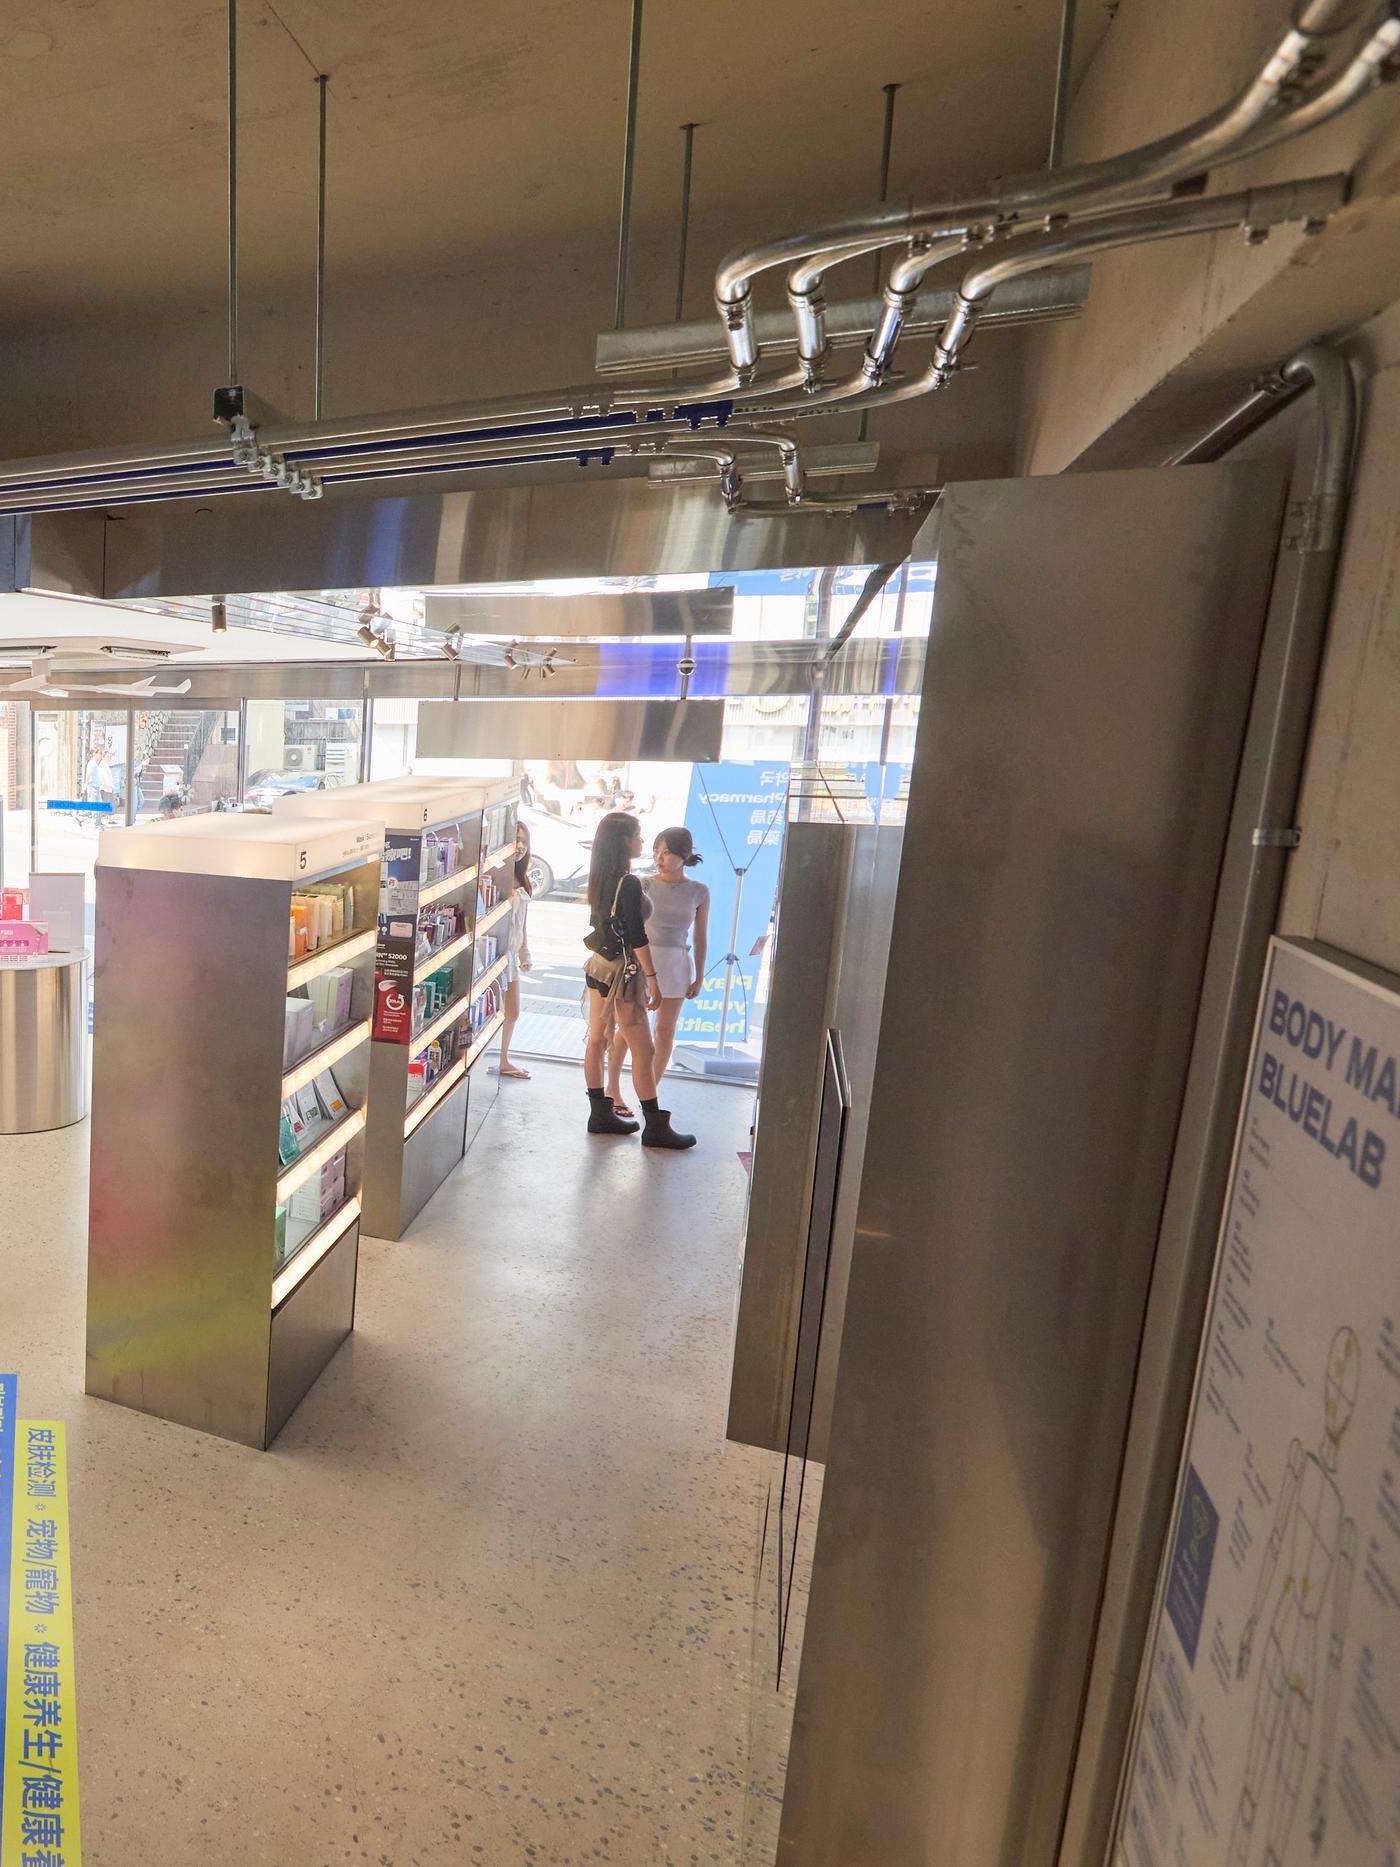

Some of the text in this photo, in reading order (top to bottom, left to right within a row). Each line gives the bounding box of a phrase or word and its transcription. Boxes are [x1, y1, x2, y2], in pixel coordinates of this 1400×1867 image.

[423, 808, 429, 822] 6
[299, 851, 308, 870] 5
[1268, 990, 1400, 1120] BODY MA
[1258, 1053, 1386, 1190] BLUELAB
[27, 1427, 57, 1498] 皮肤检测
[22, 1518, 58, 1615] 宠物/寵物
